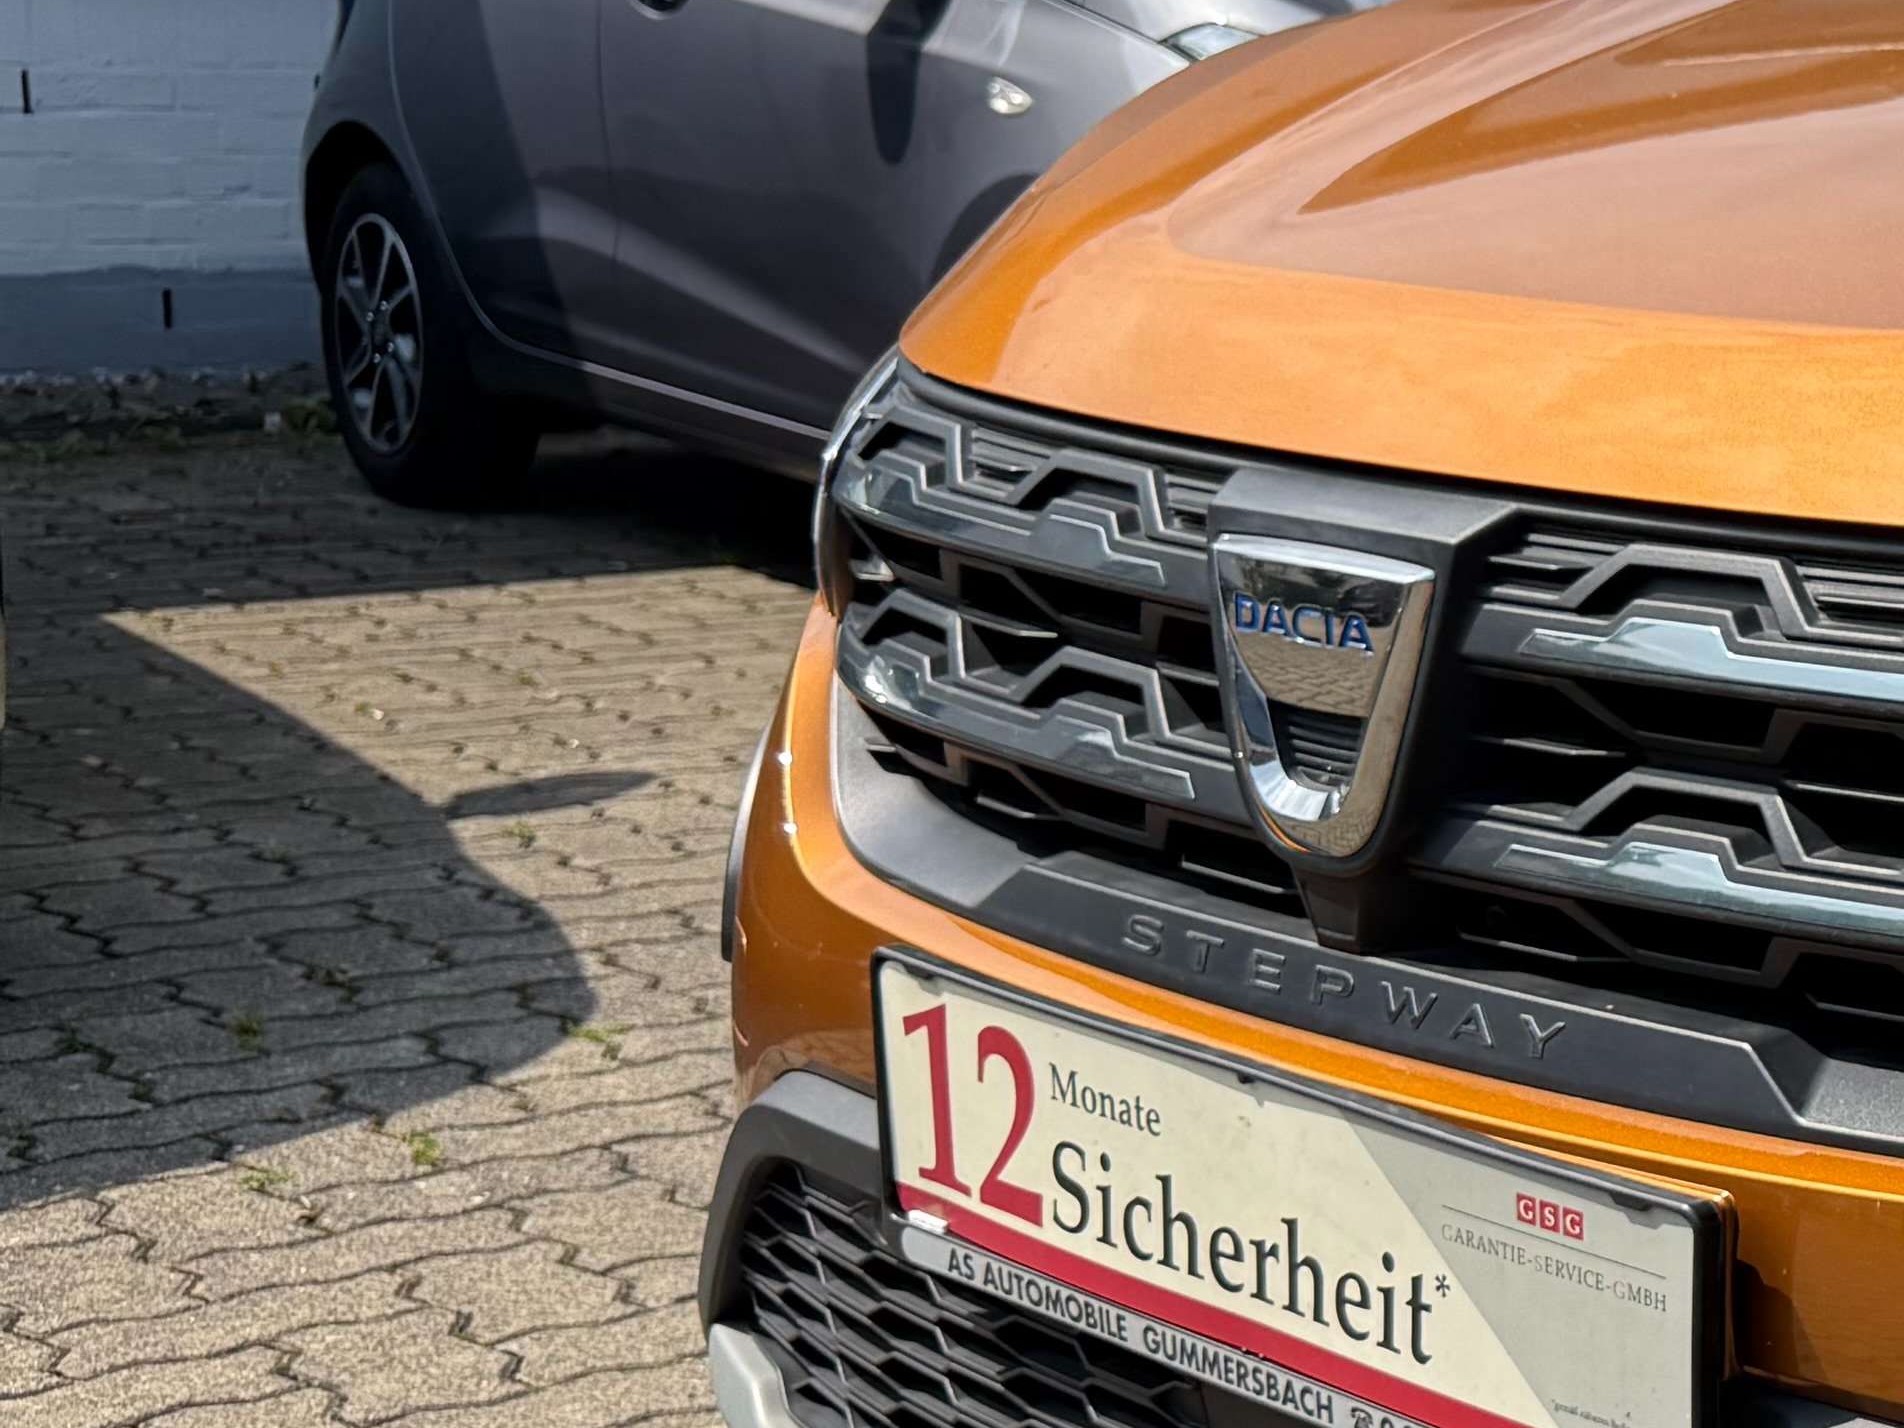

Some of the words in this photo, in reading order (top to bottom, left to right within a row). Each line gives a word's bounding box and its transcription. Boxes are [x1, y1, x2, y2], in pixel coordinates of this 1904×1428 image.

[1234, 591, 1374, 656] DACIA
[1123, 913, 1570, 1060] STEPWAY
[903, 1003, 1044, 1228] 12
[1048, 1062, 1162, 1138] Monate
[1441, 1222, 1668, 1313] GARANTIE-SERVICE-GMBH
[1518, 1196, 1583, 1237] GSG
[948, 1248, 976, 1281] AS
[983, 1260, 1130, 1342] AUTOMOBILE
[1144, 1327, 1335, 1426] GUMMERSBACH
